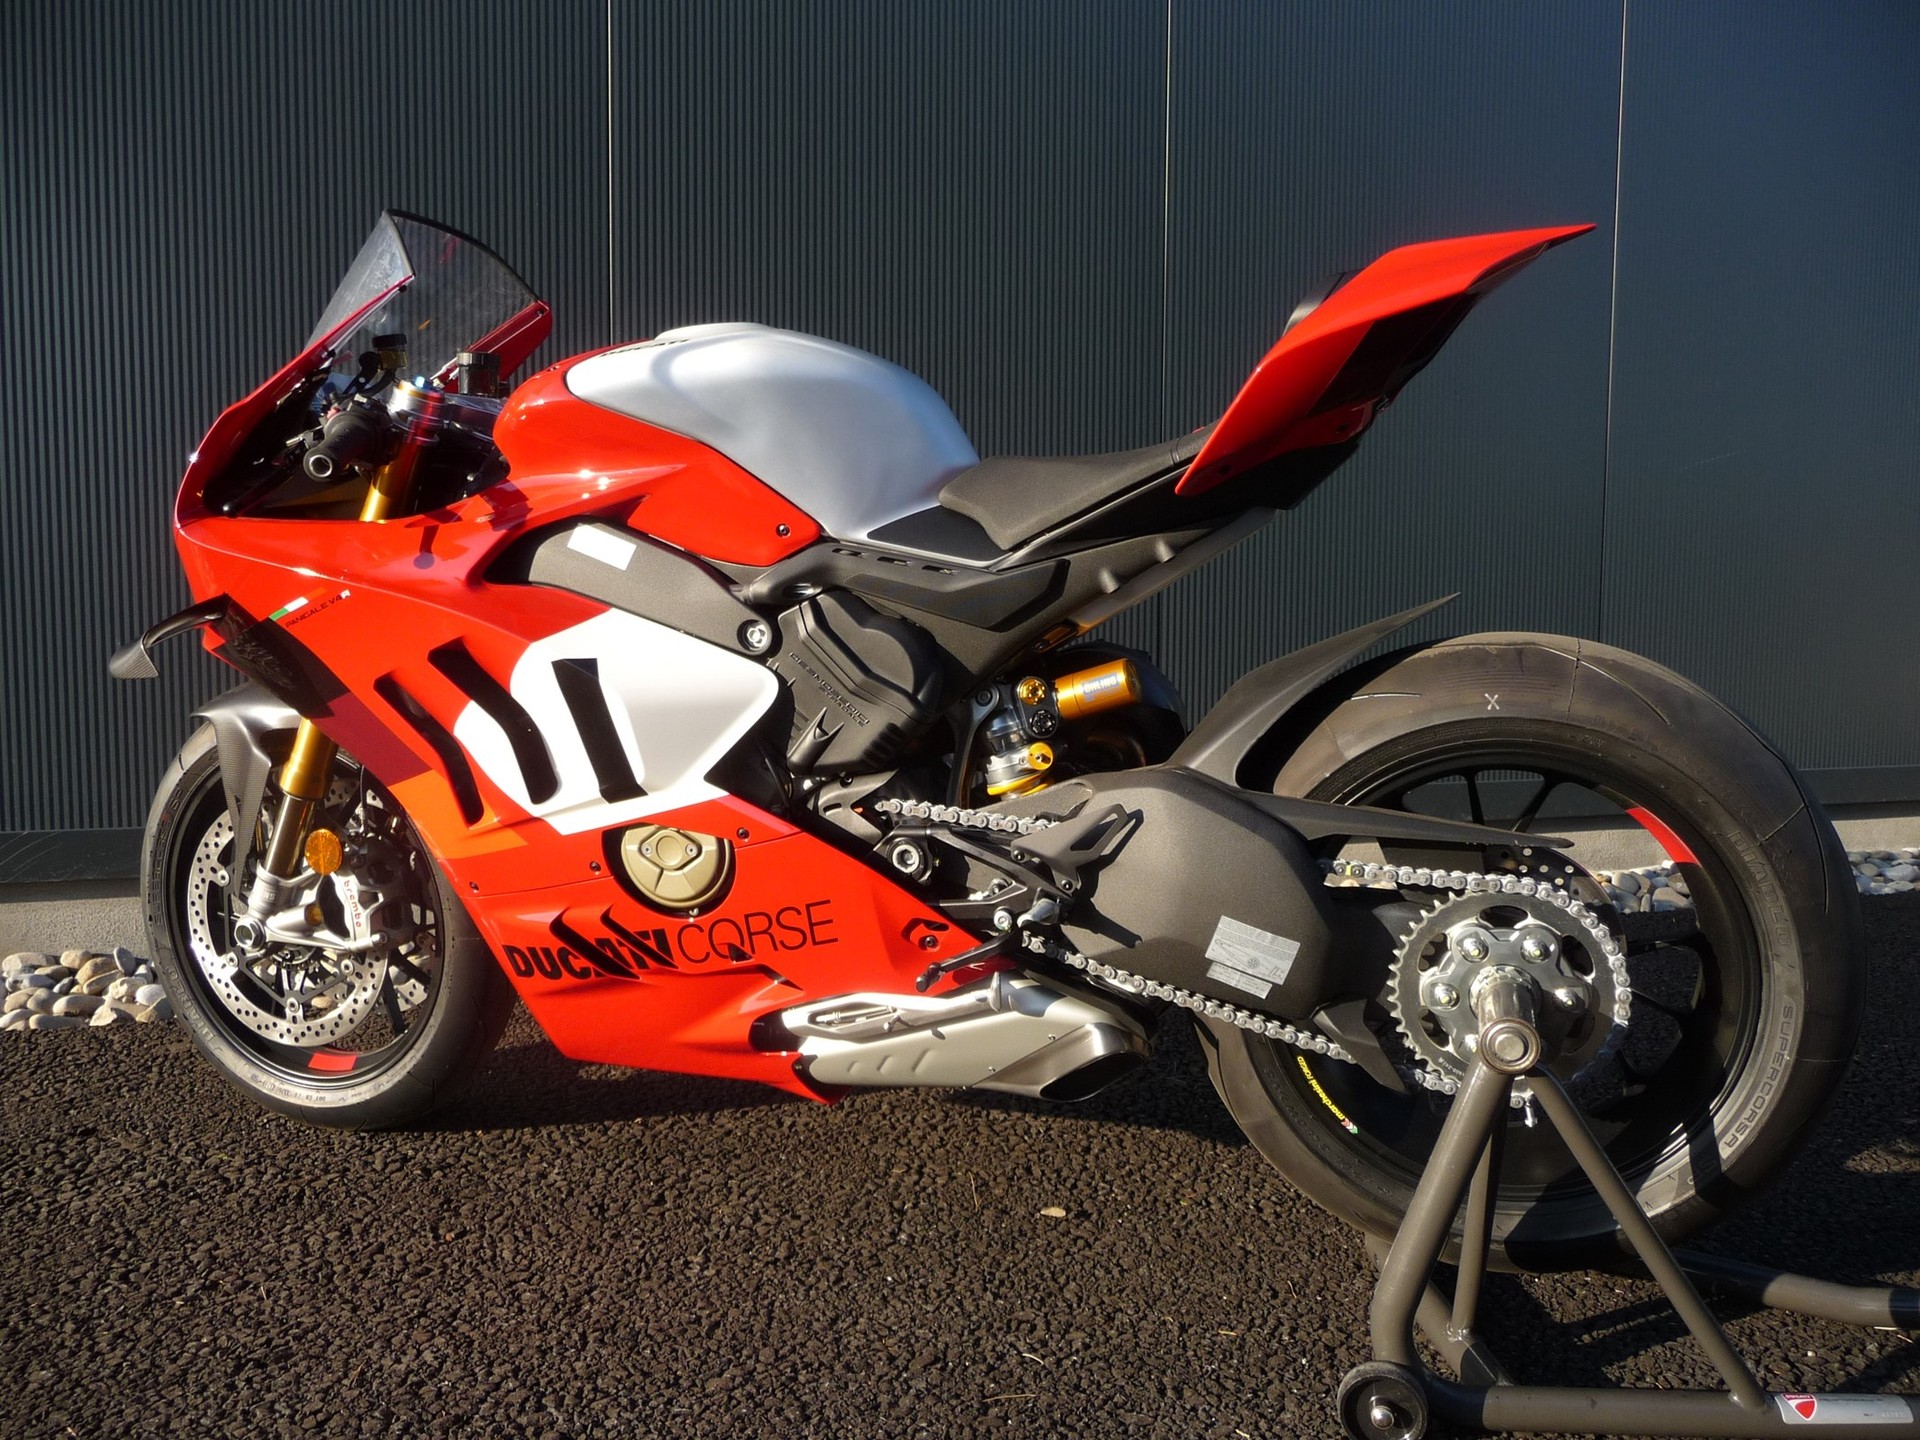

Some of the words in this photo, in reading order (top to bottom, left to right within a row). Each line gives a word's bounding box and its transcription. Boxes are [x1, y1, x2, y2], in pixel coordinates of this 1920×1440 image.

[343, 879, 362, 928] brembo
[676, 899, 838, 964] CORSE
[1309, 1079, 1346, 1121] marchesini
[1704, 1004, 1794, 1148] SUPERCORSA
